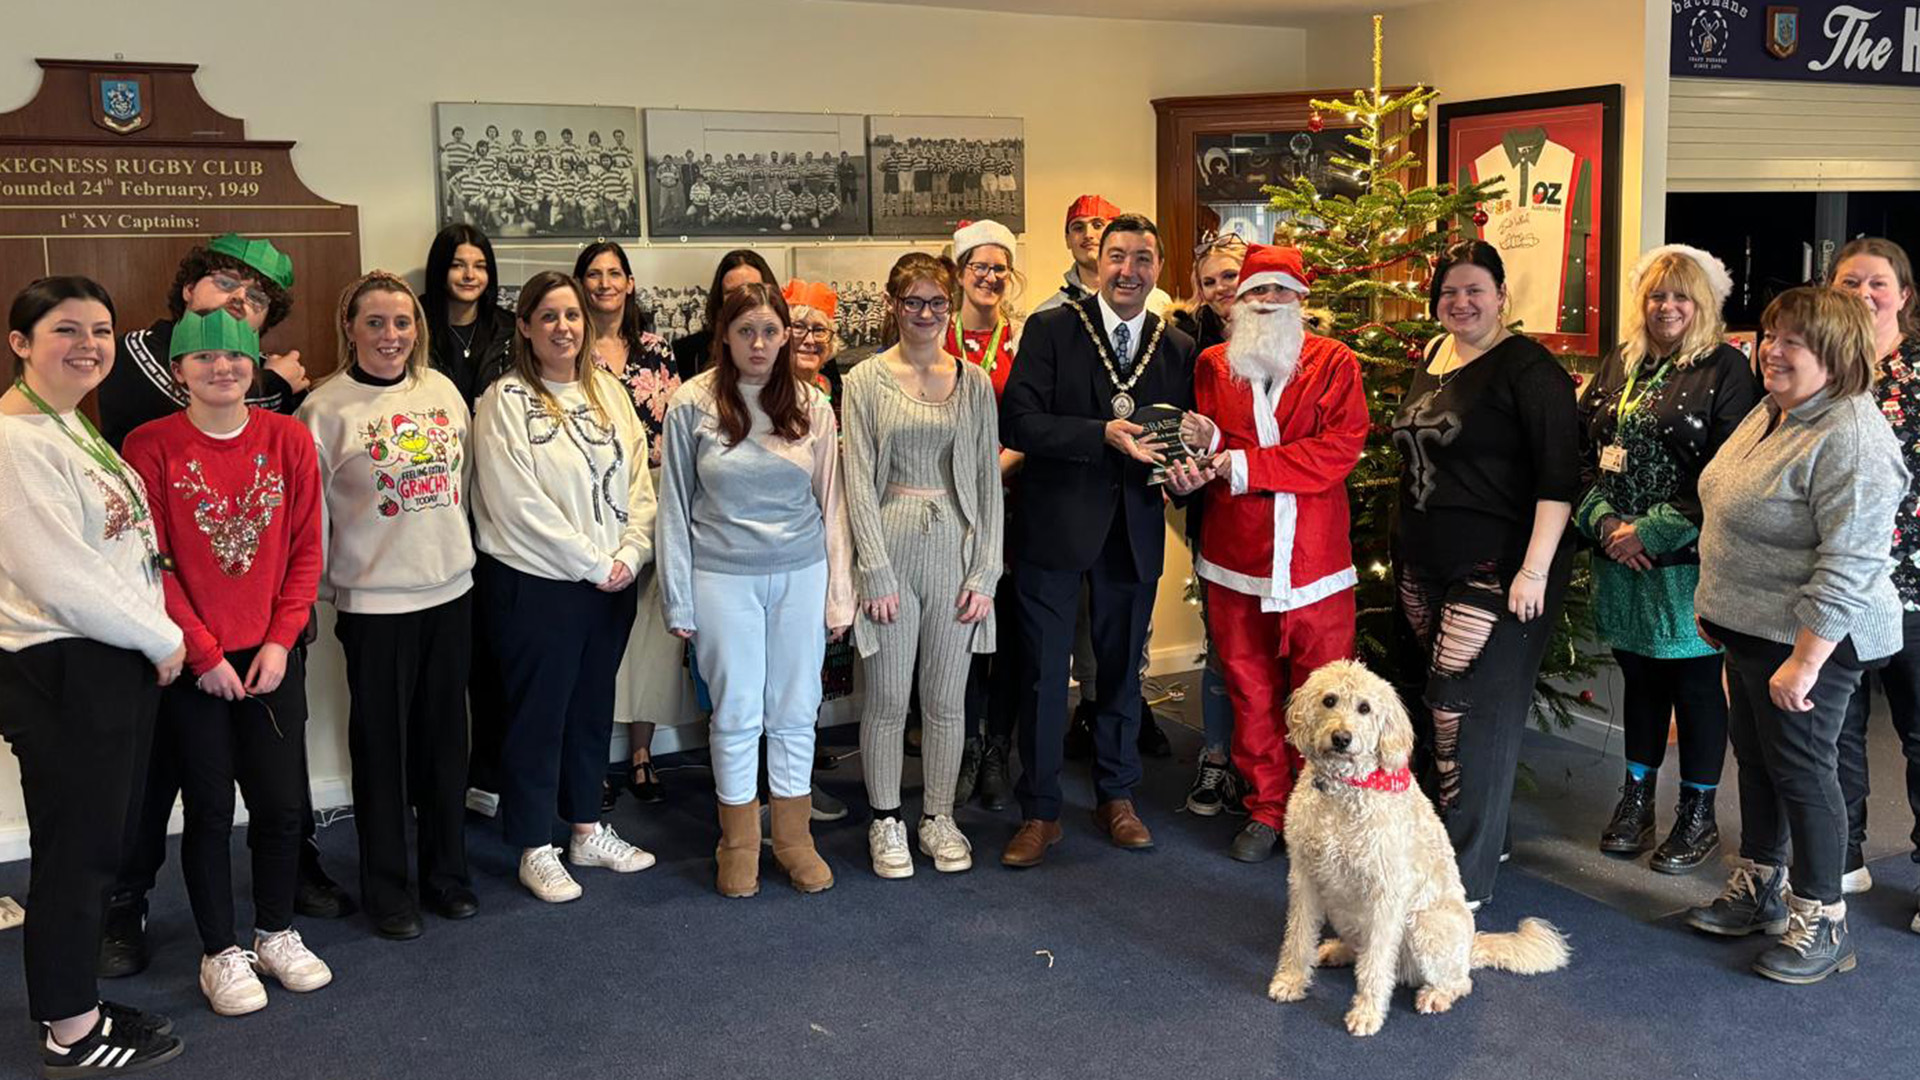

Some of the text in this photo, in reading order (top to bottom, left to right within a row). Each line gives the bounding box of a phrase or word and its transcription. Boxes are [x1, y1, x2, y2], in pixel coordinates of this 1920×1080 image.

[1807, 5, 1894, 71] The
[115, 158, 198, 175] RUGBY
[202, 160, 263, 175] CLUB
[81, 177, 114, 196] 24th
[120, 181, 213, 200] February,
[219, 182, 260, 197] 1949
[1532, 181, 1562, 205] OZ
[60, 212, 200, 231] 1st XV Captains:
[402, 465, 445, 480] FEELING EXTRA
[414, 494, 438, 506] TODAY
